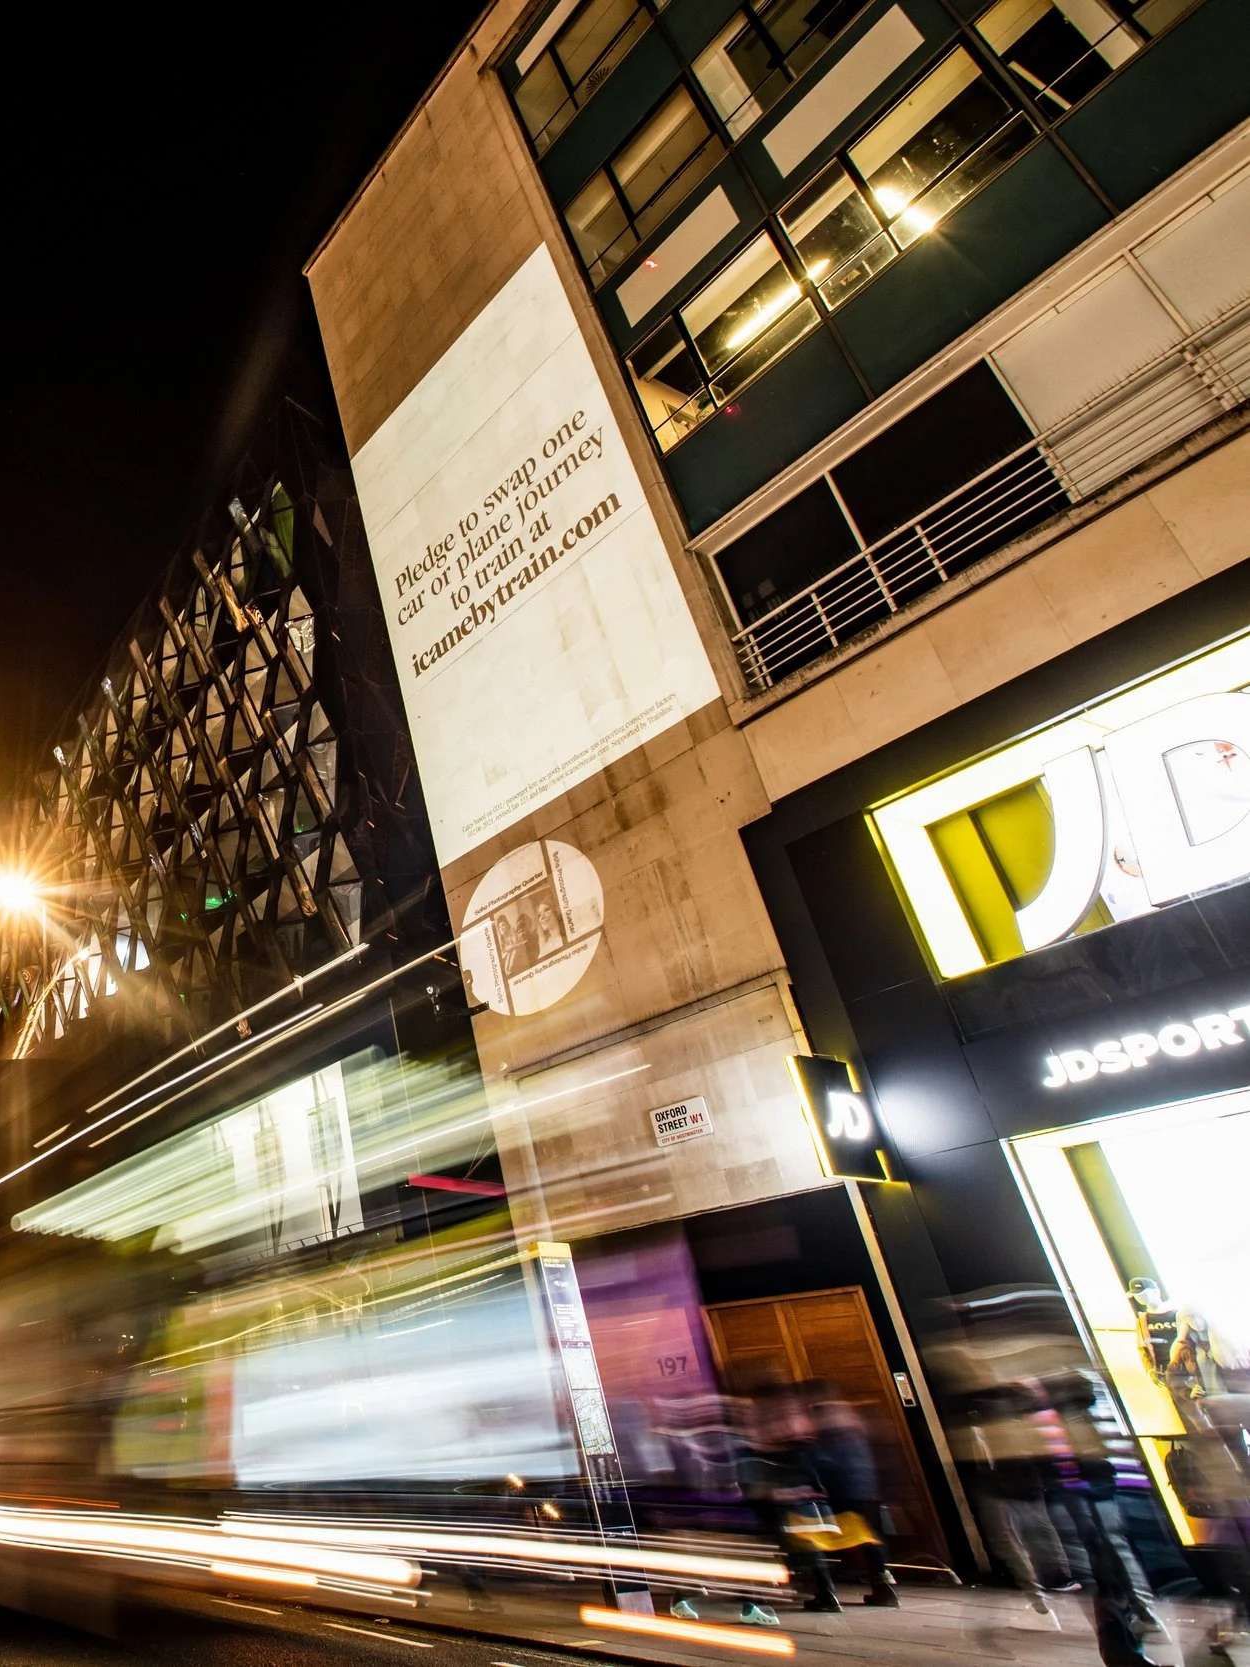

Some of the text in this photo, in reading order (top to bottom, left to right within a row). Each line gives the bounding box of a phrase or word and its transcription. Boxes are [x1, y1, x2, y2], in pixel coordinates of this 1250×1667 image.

[394, 410, 587, 599] Pledge to swap one
[398, 426, 603, 626] car or plane journey
[450, 510, 552, 611] to train at
[412, 492, 622, 678] icamebytrain.com
[599, 727, 626, 745] reporting
[625, 705, 656, 729] conversion
[611, 725, 640, 747] Supported
[474, 870, 544, 916] Soho Photography Quarter
[552, 851, 576, 935] Soho Photography Quarter
[490, 948, 500, 988] Photography
[513, 944, 589, 986] Soho Photography Quarter
[655, 1105, 687, 1122] OXFORD
[658, 1113, 704, 1133] STREET W1
[677, 1128, 703, 1140] WESTMINSTER
[828, 1091, 872, 1141] JD
[656, 1356, 687, 1377] 197
